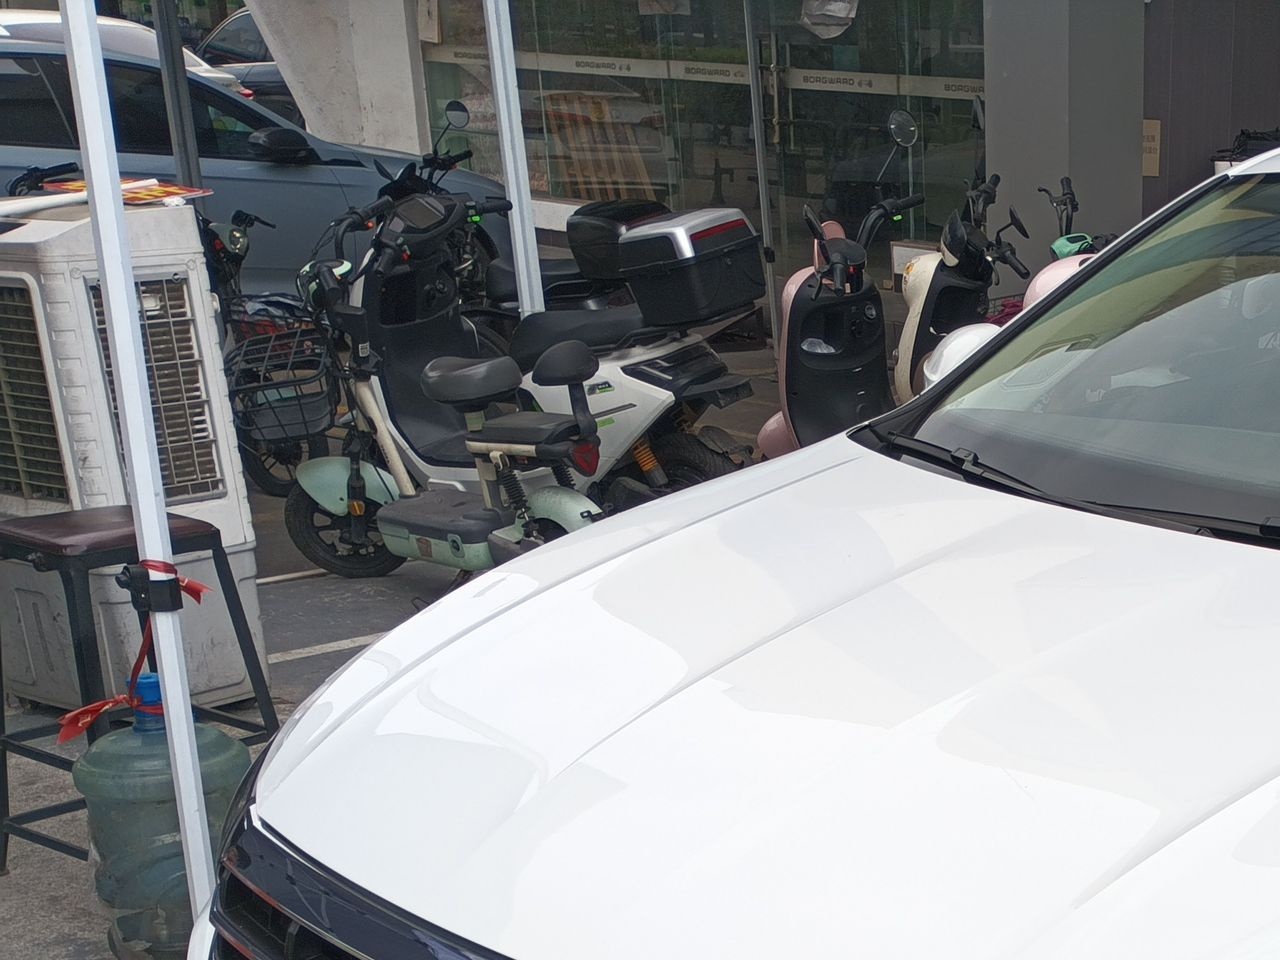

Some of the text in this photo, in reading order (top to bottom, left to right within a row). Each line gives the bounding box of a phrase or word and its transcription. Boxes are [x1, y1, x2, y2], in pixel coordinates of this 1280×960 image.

[453, 51, 488, 60] BORGWAR
[575, 60, 617, 71] BORGWARD
[684, 66, 731, 77] BORGWARD
[802, 75, 855, 86] BORGWARD
[943, 83, 985, 94] BORGWA
